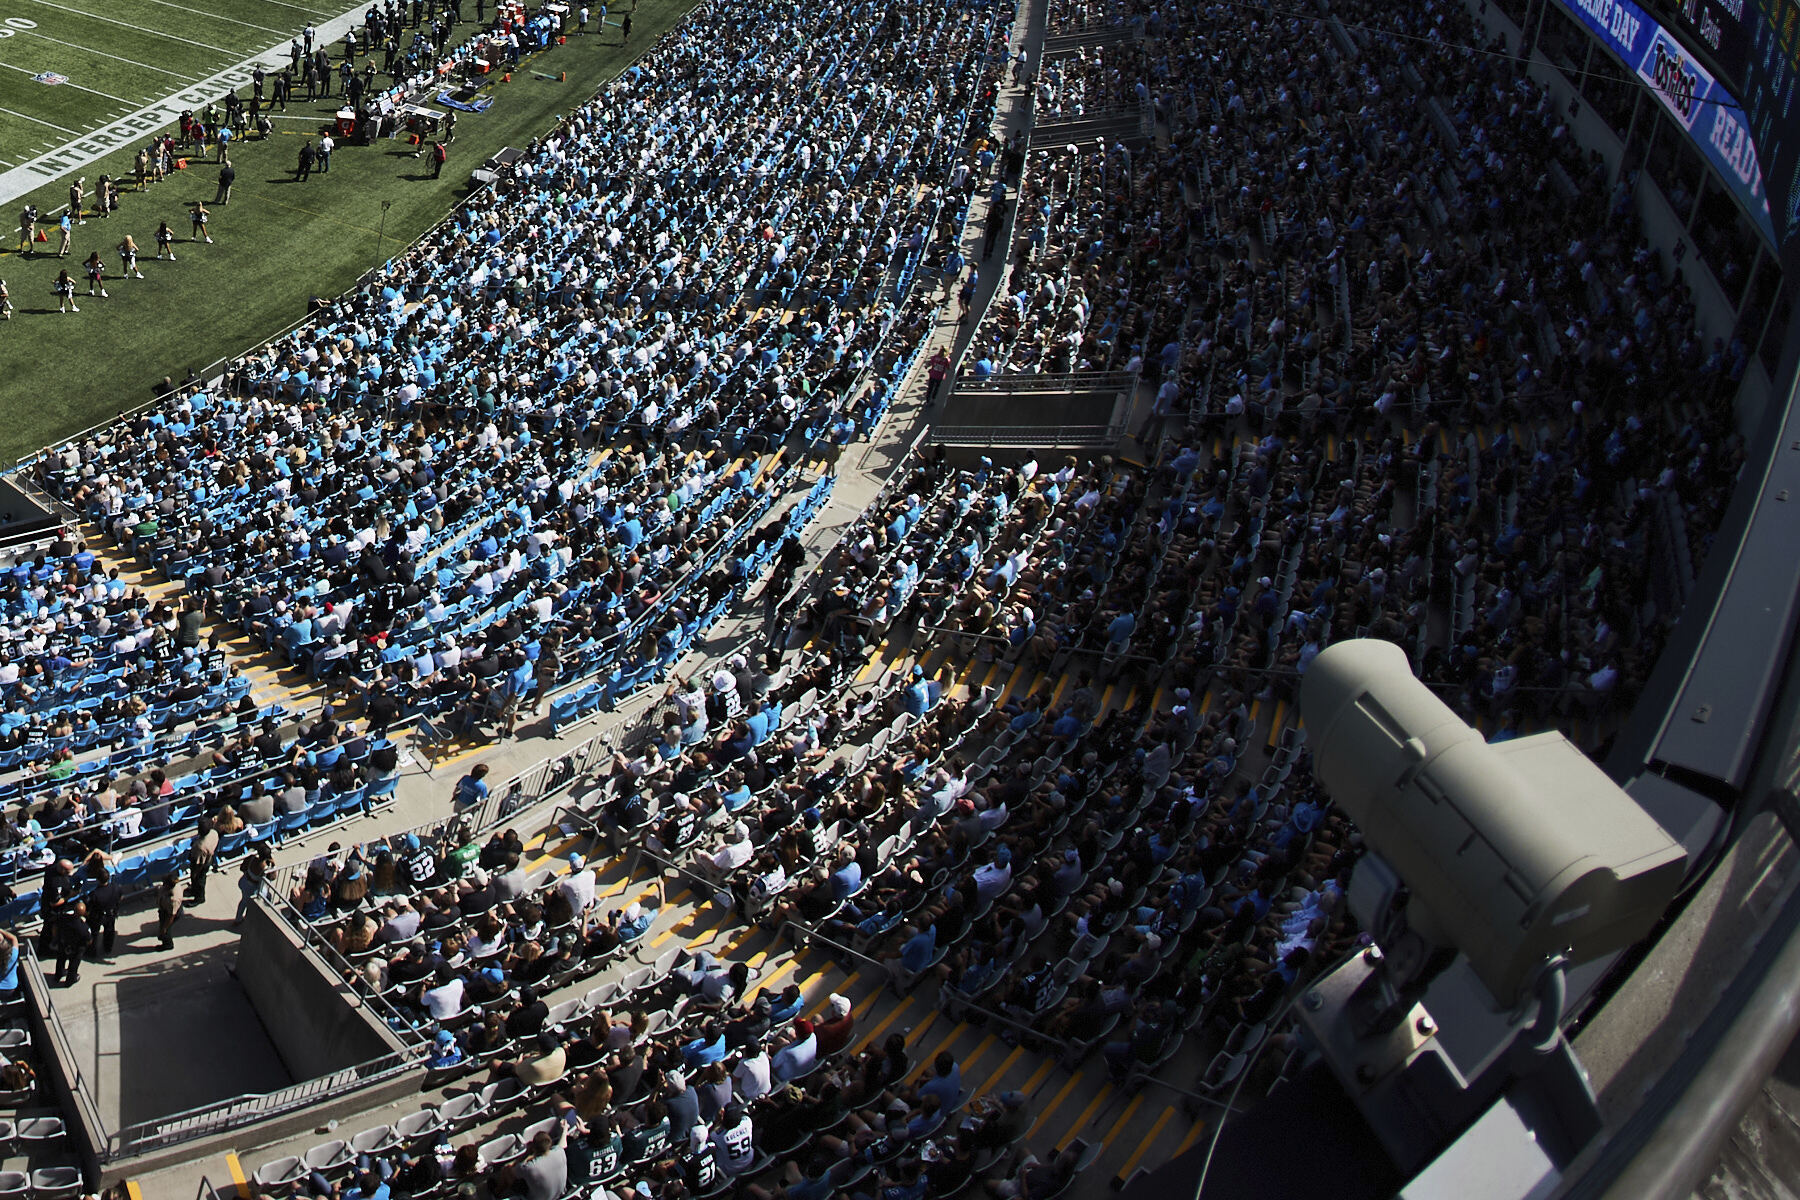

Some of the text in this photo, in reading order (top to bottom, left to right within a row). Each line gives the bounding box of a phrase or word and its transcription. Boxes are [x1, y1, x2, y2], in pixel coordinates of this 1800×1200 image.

[1610, 2, 1640, 52] DAY
[1699, 7, 1721, 51] Davis
[26, 60, 276, 177] INTERCEPT CANCER
[409, 856, 436, 882] 22
[727, 1136, 752, 1160] 59
[588, 1152, 617, 1178] 63
[698, 1165, 716, 1187] 21
